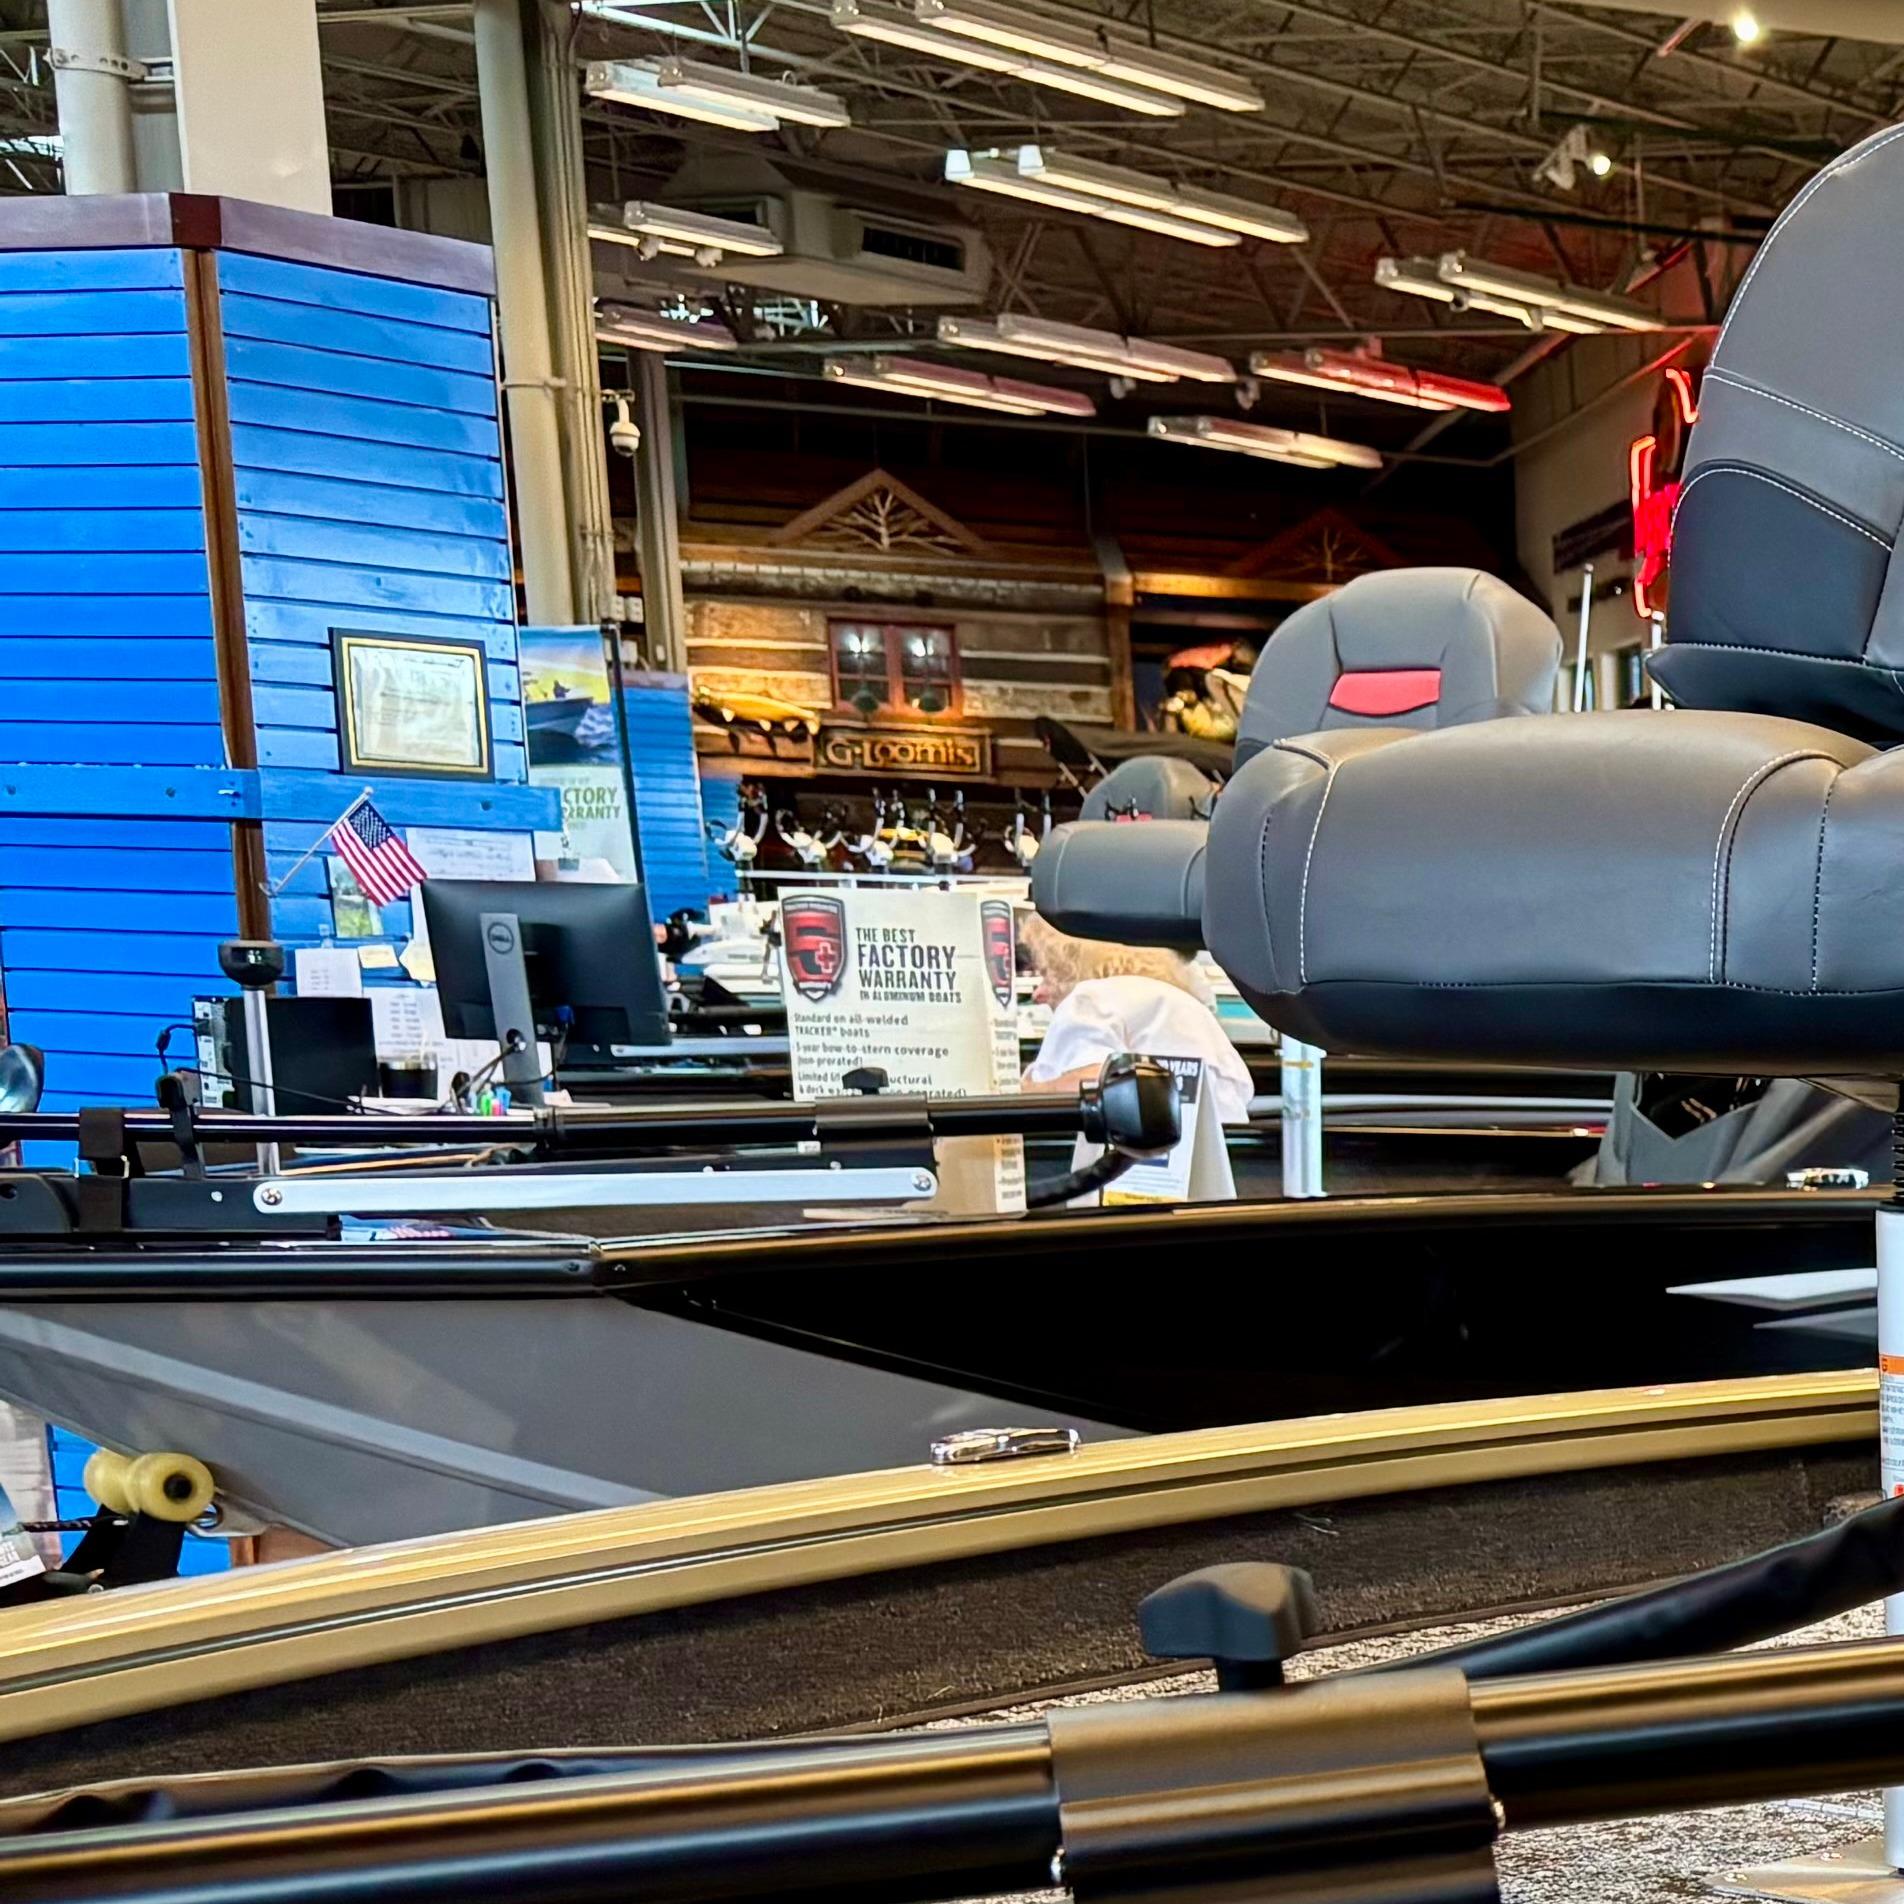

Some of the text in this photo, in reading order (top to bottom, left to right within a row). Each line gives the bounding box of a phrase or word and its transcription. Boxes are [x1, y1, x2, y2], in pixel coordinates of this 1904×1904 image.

[563, 787, 617, 803] CTORY
[856, 927, 916, 944] THE BEST
[857, 944, 956, 970] FACTORY
[858, 969, 957, 990] WARRANTY
[872, 991, 926, 1002] ALUMINUM
[929, 992, 962, 1004] BOATS
[794, 1012, 832, 1024] Standard
[834, 1014, 847, 1024] on
[840, 1025, 870, 1038] boats
[894, 1046, 950, 1059] coverage
